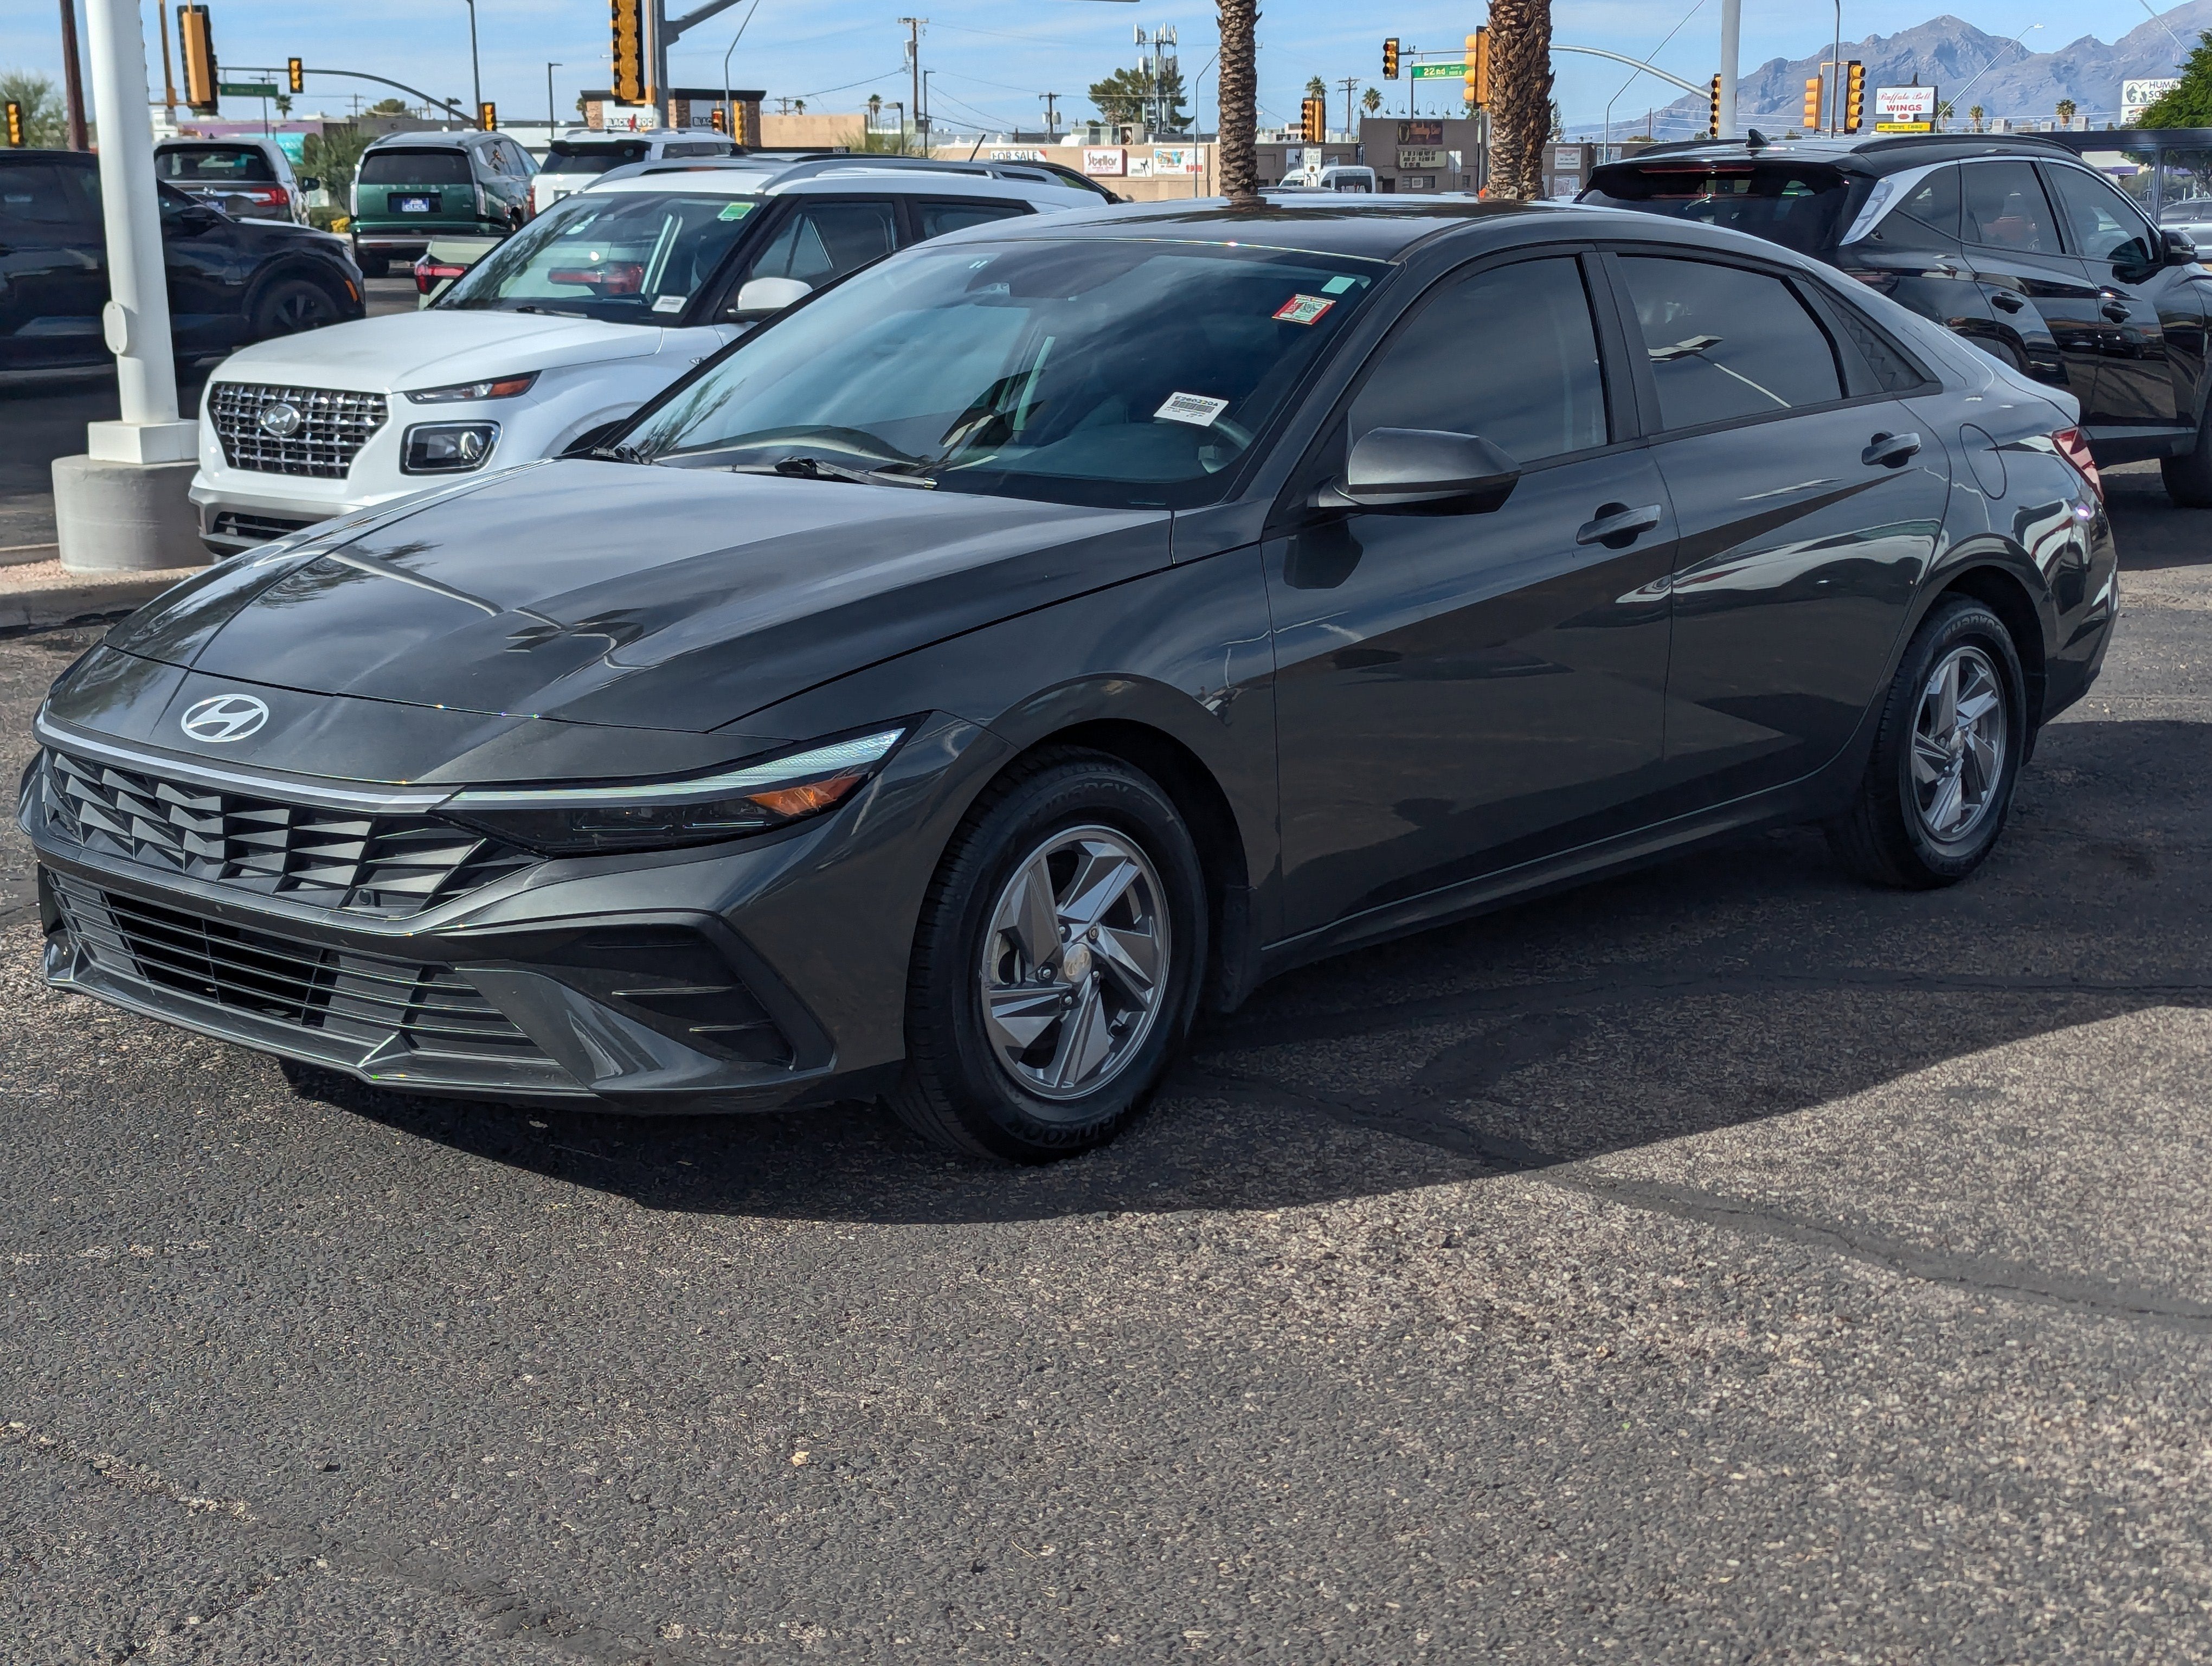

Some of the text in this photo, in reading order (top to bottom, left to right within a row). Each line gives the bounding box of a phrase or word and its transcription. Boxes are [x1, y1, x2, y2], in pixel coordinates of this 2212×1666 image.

[605, 118, 629, 127] BLACK
[693, 117, 712, 126] BLAC
[992, 151, 1038, 161] FOR SALE
